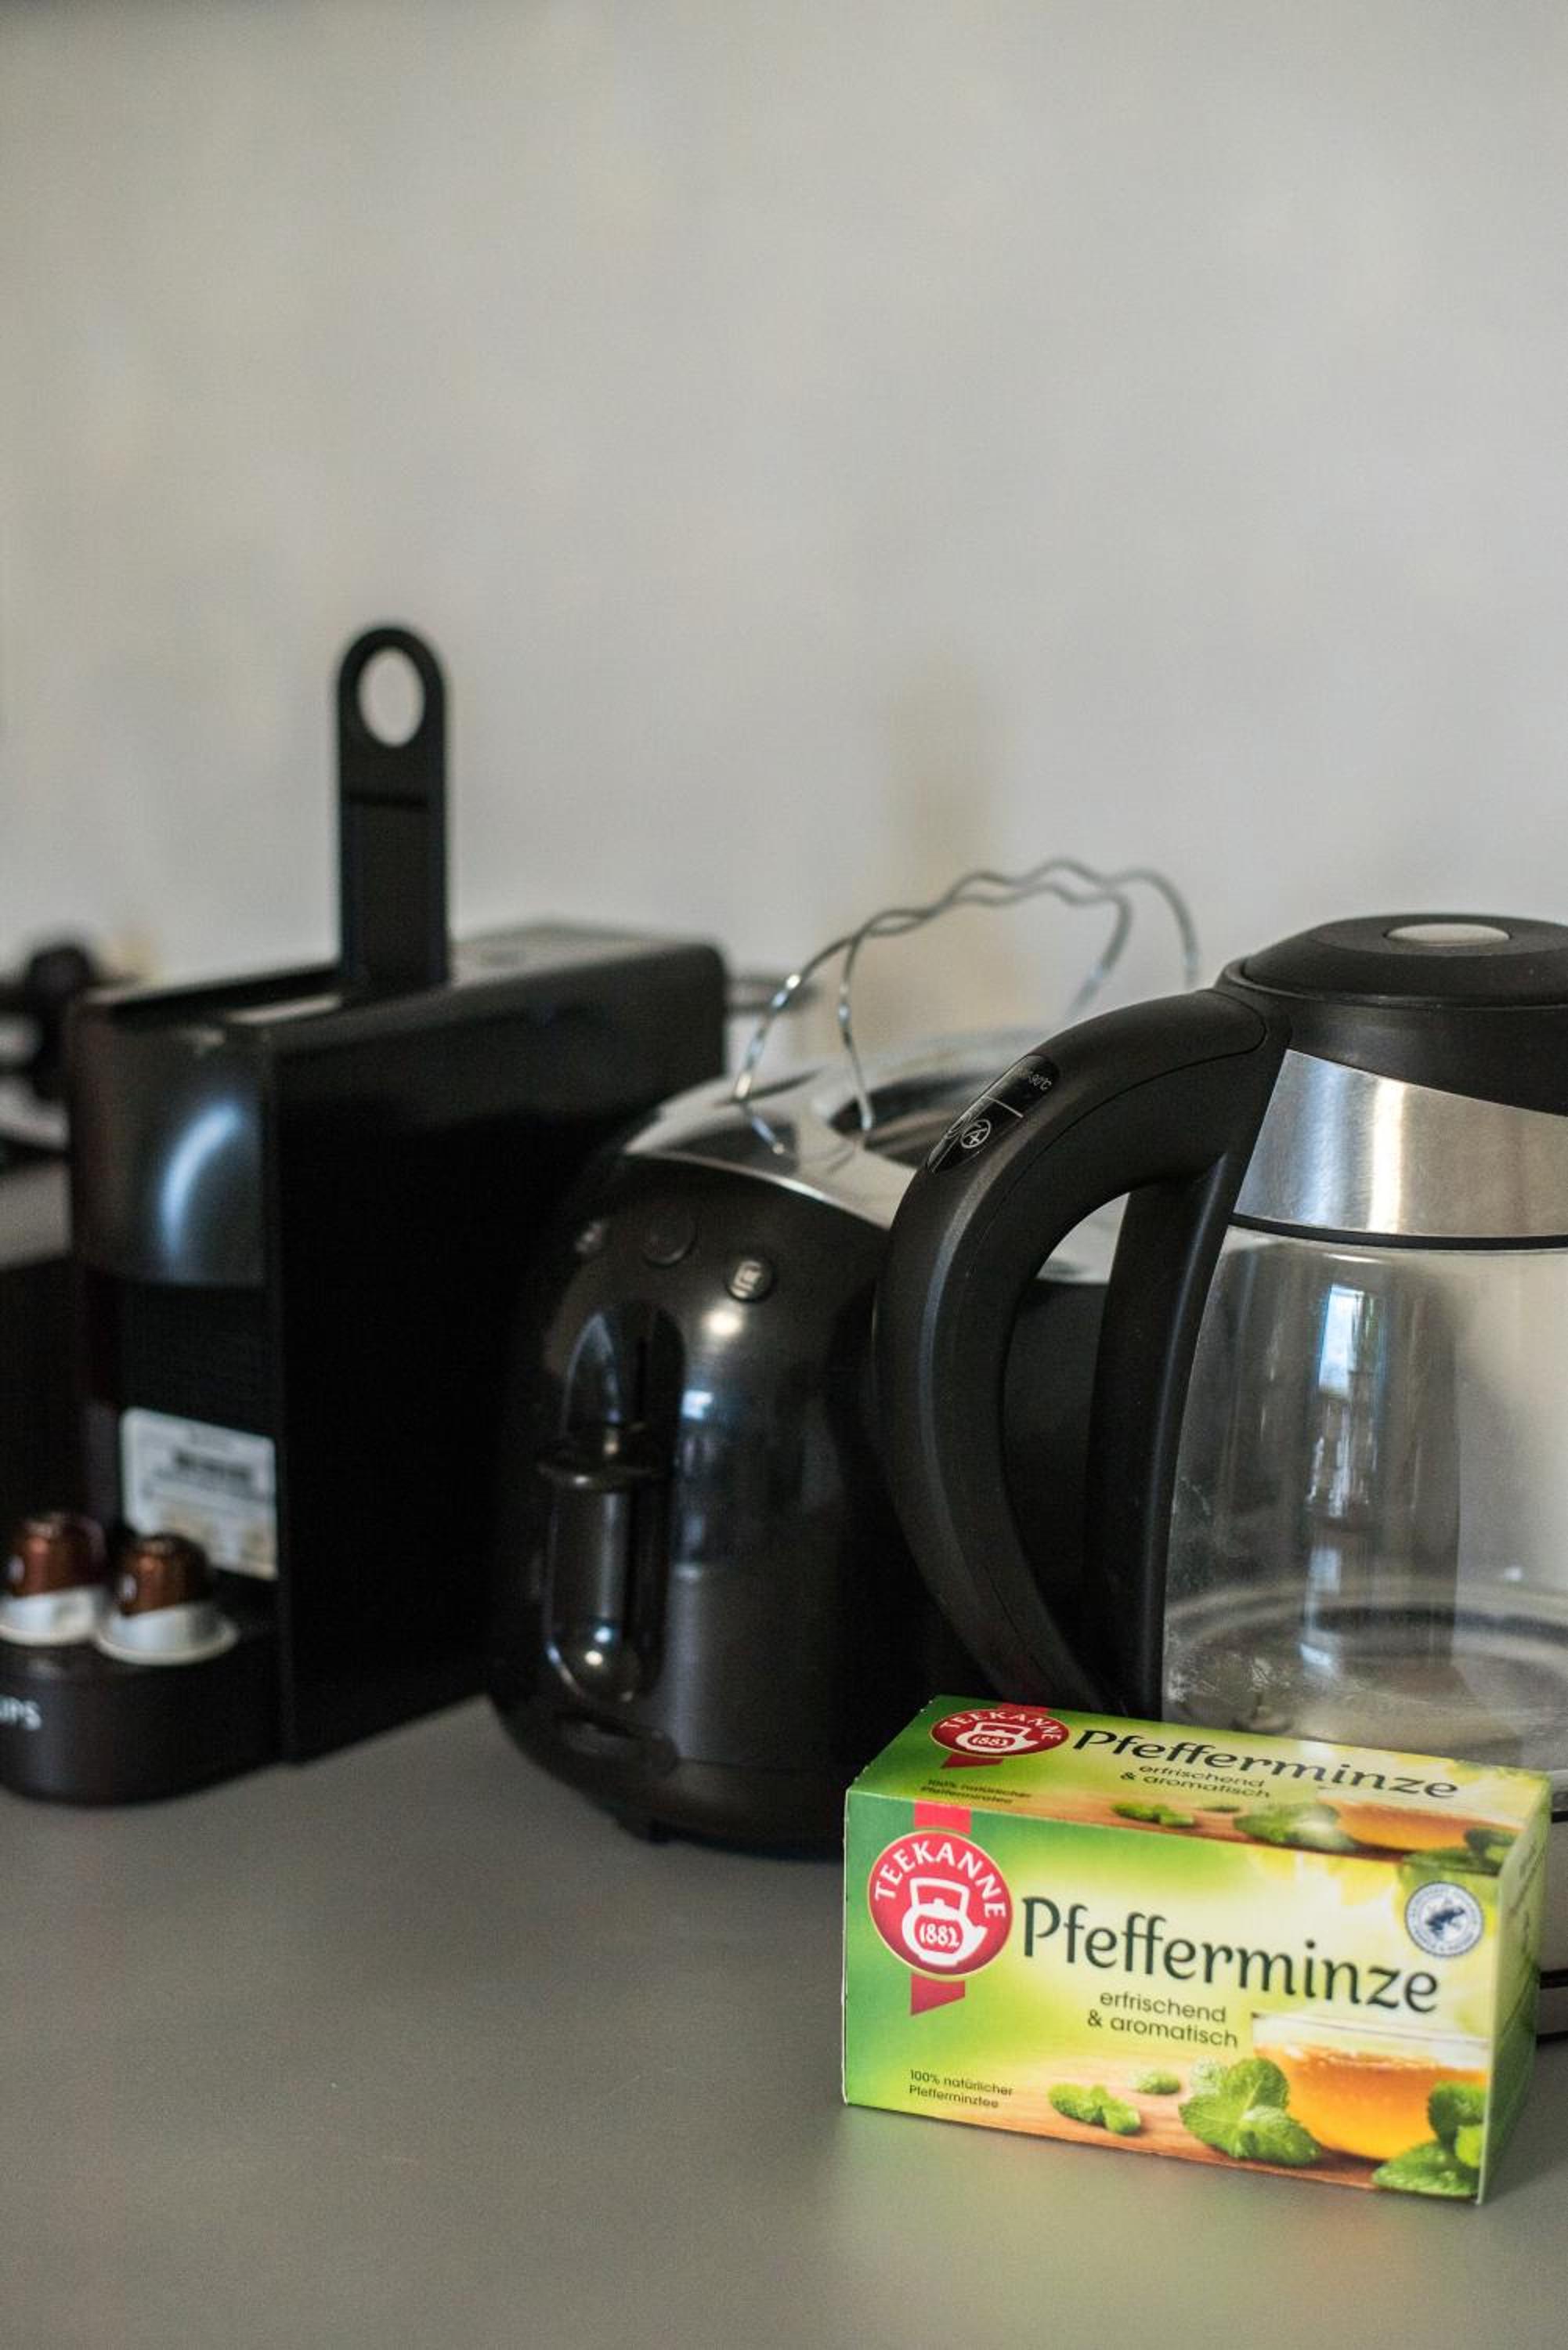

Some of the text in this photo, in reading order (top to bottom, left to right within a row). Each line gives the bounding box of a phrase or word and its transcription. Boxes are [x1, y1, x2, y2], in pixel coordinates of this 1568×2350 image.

[940, 1711, 1062, 1740] TEEKANNE
[1072, 1730, 1458, 1799] Pfefferminze
[1139, 1763, 1265, 1788] erfrischend
[1121, 1771, 1270, 1799] & aromatisch
[875, 1840, 1006, 1918] TEEKANNE
[919, 1922, 959, 1947] 1882
[1022, 1896, 1438, 2013] Pfefferminze
[1100, 1991, 1227, 2023] erfrischend
[1087, 2008, 1237, 2048] & aromatisch
[909, 2084, 999, 2108] Pfefferminztee
[910, 2069, 1013, 2096] 100% natürlicher
